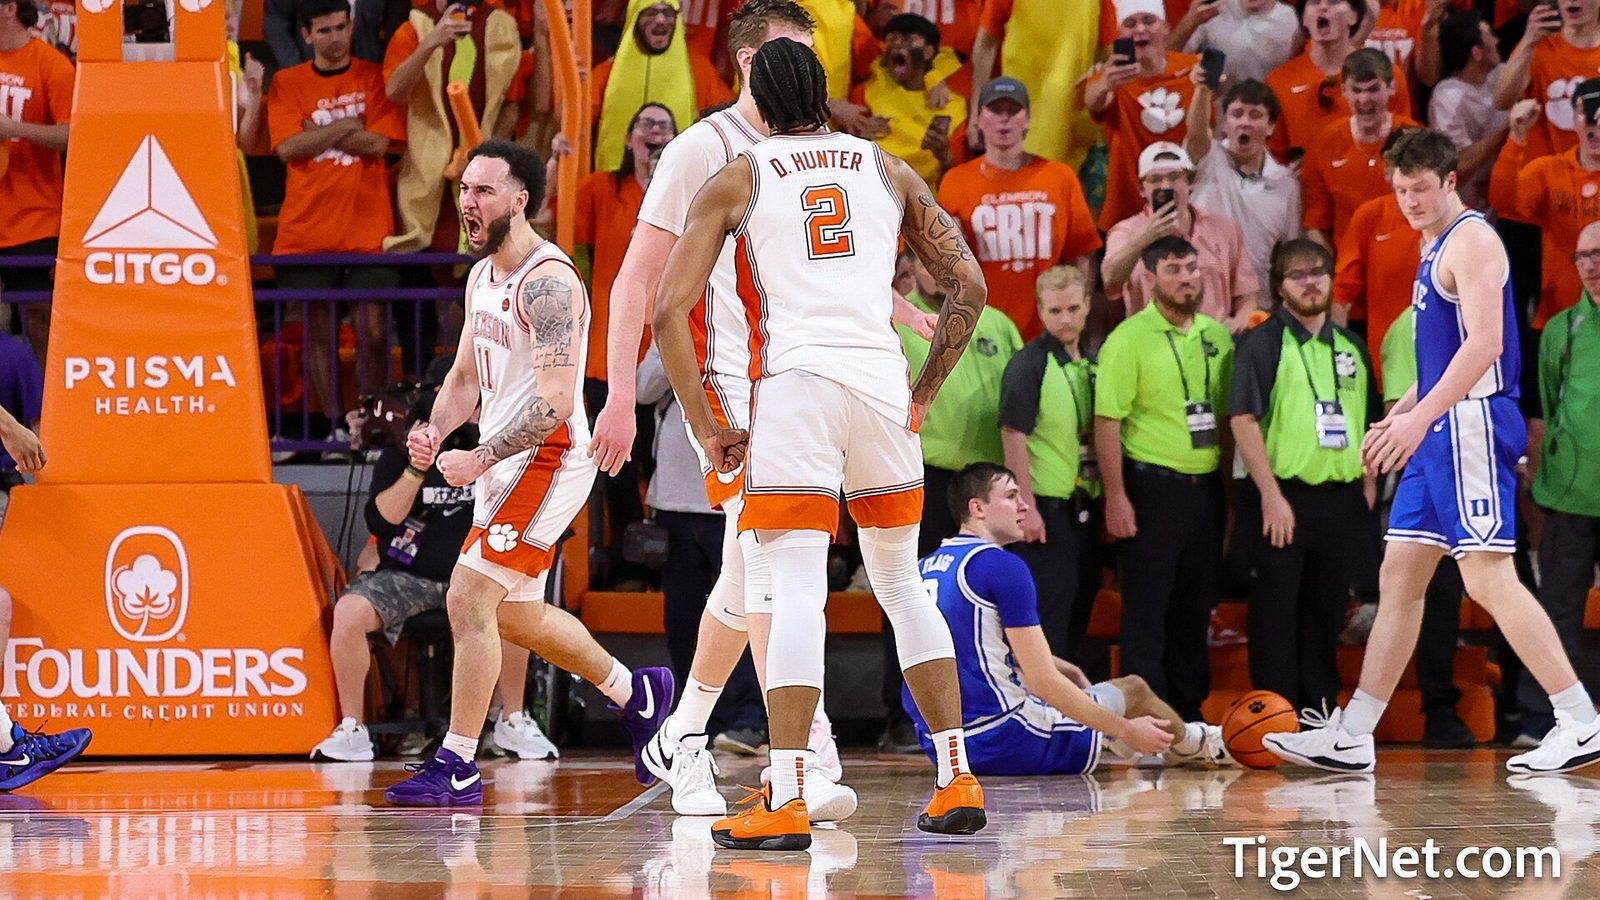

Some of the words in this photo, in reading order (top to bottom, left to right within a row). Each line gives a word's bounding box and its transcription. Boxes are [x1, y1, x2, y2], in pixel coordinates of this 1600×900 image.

[769, 158, 795, 178] D.
[790, 150, 863, 172] HUNTER
[800, 183, 855, 260] 2
[971, 202, 1056, 262] GRIT
[84, 252, 216, 285] CITGO
[65, 355, 237, 390] PRISMA
[477, 344, 496, 393] 11
[95, 396, 204, 416] HEALTH
[1, 637, 308, 698] FOUNDERS
[122, 703, 215, 722] CREDIT
[227, 702, 304, 717] UNION
